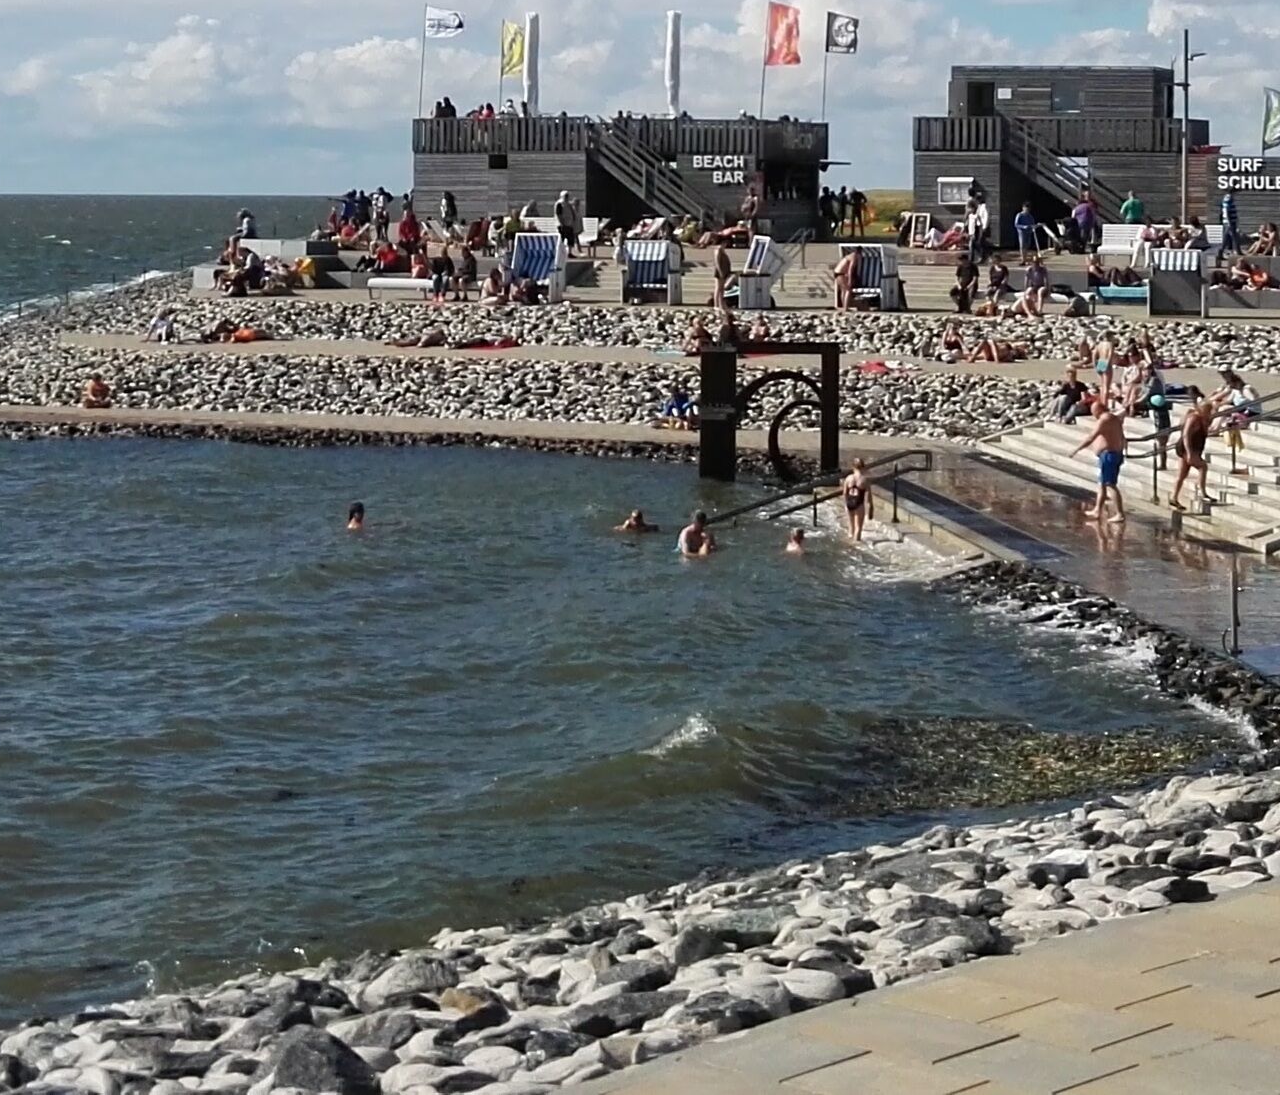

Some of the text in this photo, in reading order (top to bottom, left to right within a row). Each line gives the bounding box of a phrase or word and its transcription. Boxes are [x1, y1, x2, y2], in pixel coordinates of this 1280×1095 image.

[692, 155, 744, 168] BEACH
[1217, 158, 1263, 172] SURF
[712, 171, 744, 184] BAR
